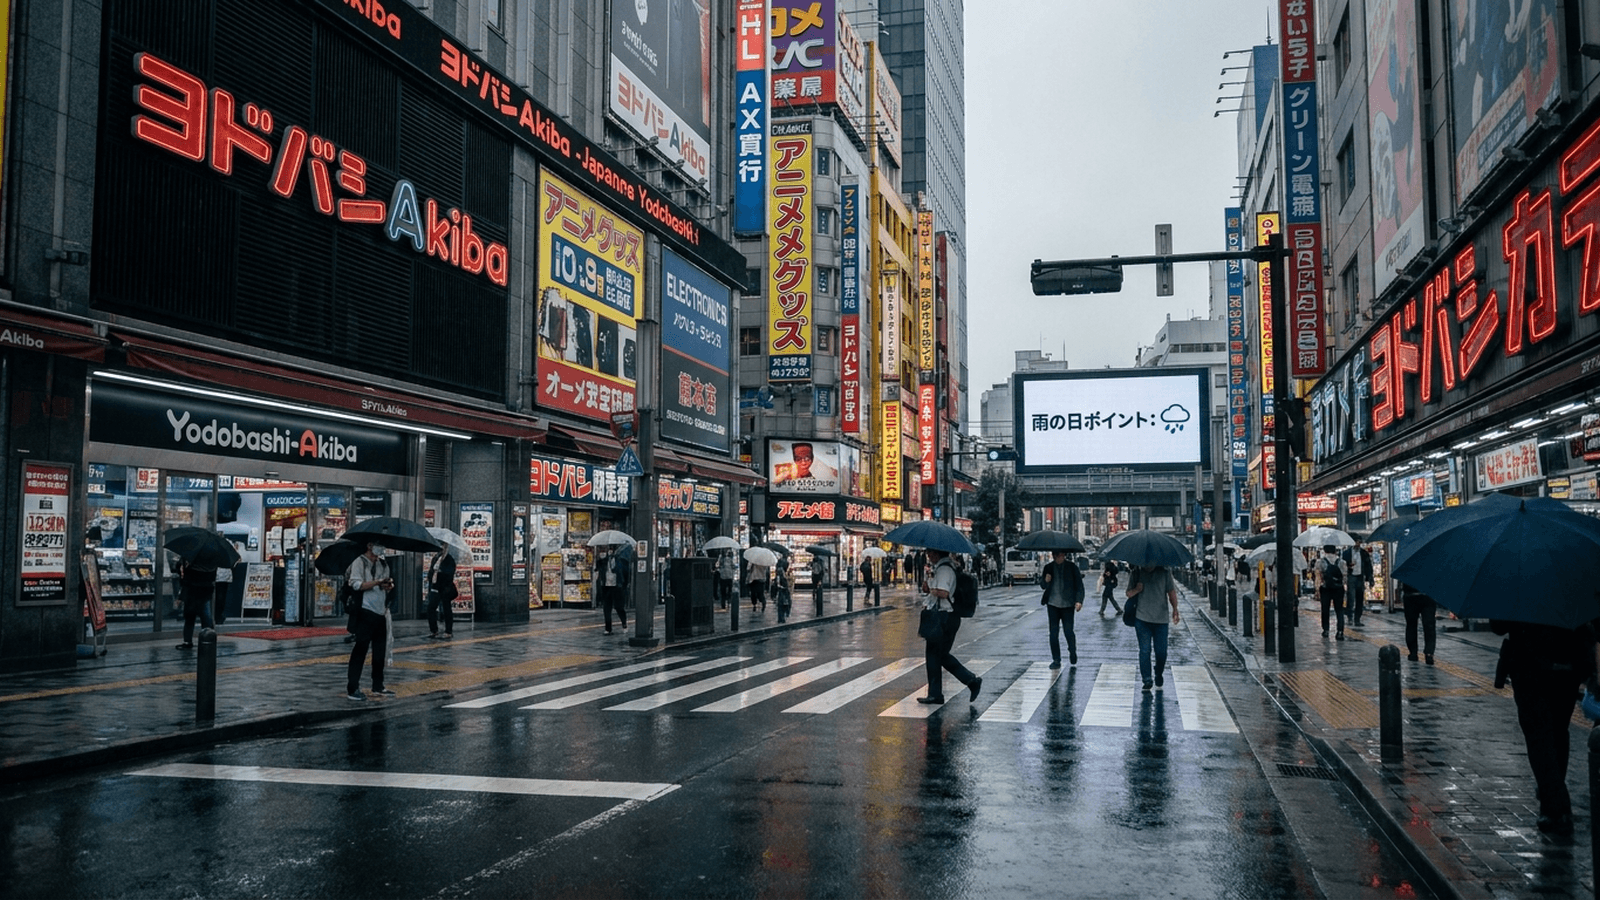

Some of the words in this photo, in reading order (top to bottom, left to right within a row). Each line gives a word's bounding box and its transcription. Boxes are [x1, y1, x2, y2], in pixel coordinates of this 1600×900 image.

[343, 0, 401, 40] kiba
[131, 52, 509, 287] ヨドバシAkiba
[166, 408, 358, 464] Yodobashi-Akiba
